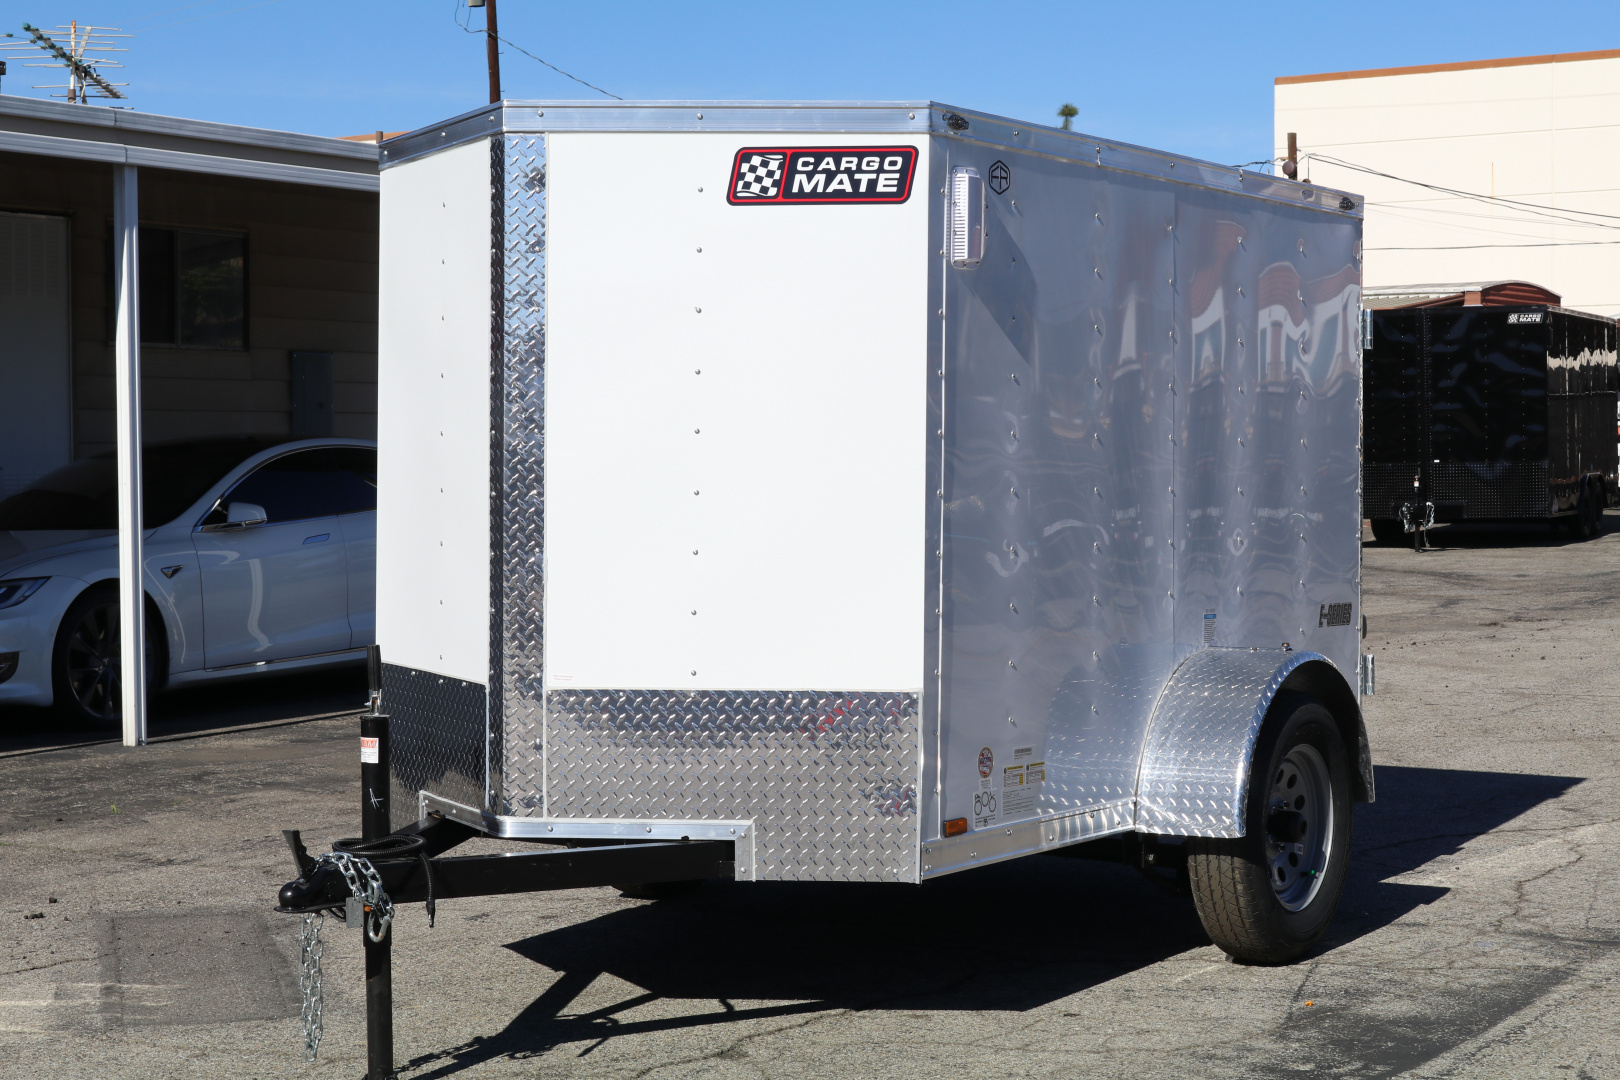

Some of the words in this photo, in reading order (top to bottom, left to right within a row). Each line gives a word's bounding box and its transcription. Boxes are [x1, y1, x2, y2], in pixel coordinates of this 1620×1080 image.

[796, 156, 903, 171] CARGO
[791, 173, 901, 193] MATE
[1318, 602, 1353, 627] E-SERIES
